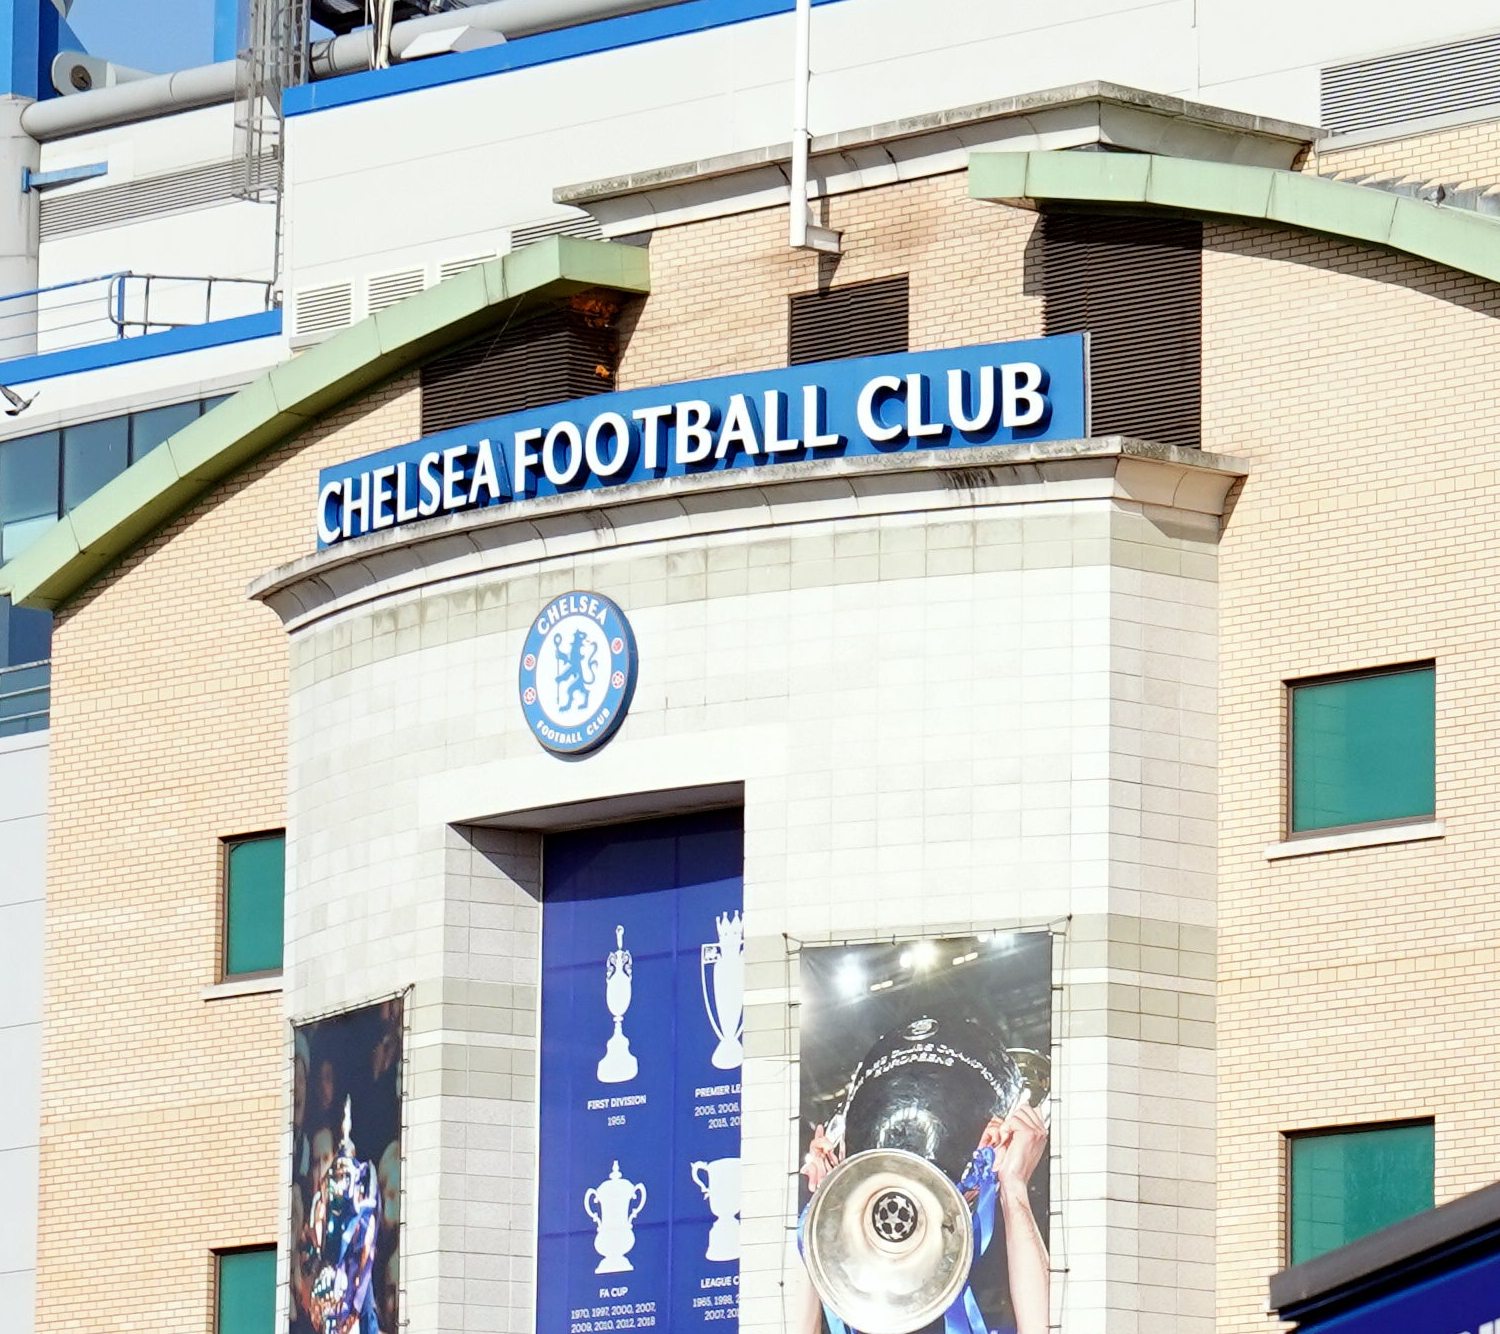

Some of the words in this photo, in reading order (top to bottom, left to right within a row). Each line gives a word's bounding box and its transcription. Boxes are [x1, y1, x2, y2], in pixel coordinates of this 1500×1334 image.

[318, 439, 501, 544] CHELSEA
[514, 385, 839, 492] FOOTBALL
[857, 362, 1045, 442] CLUB
[537, 595, 608, 635] CHELSEA
[536, 720, 583, 744] FOOTBALL
[586, 708, 610, 736] CLUB
[695, 1085, 730, 1098] PREMIER
[732, 1083, 741, 1094] LE
[587, 1099, 609, 1111] FIRST
[611, 1095, 647, 1108] DIVISION
[701, 1277, 732, 1289] LEAGUE
[599, 1288, 610, 1298] FA
[611, 1286, 629, 1298] CUP
